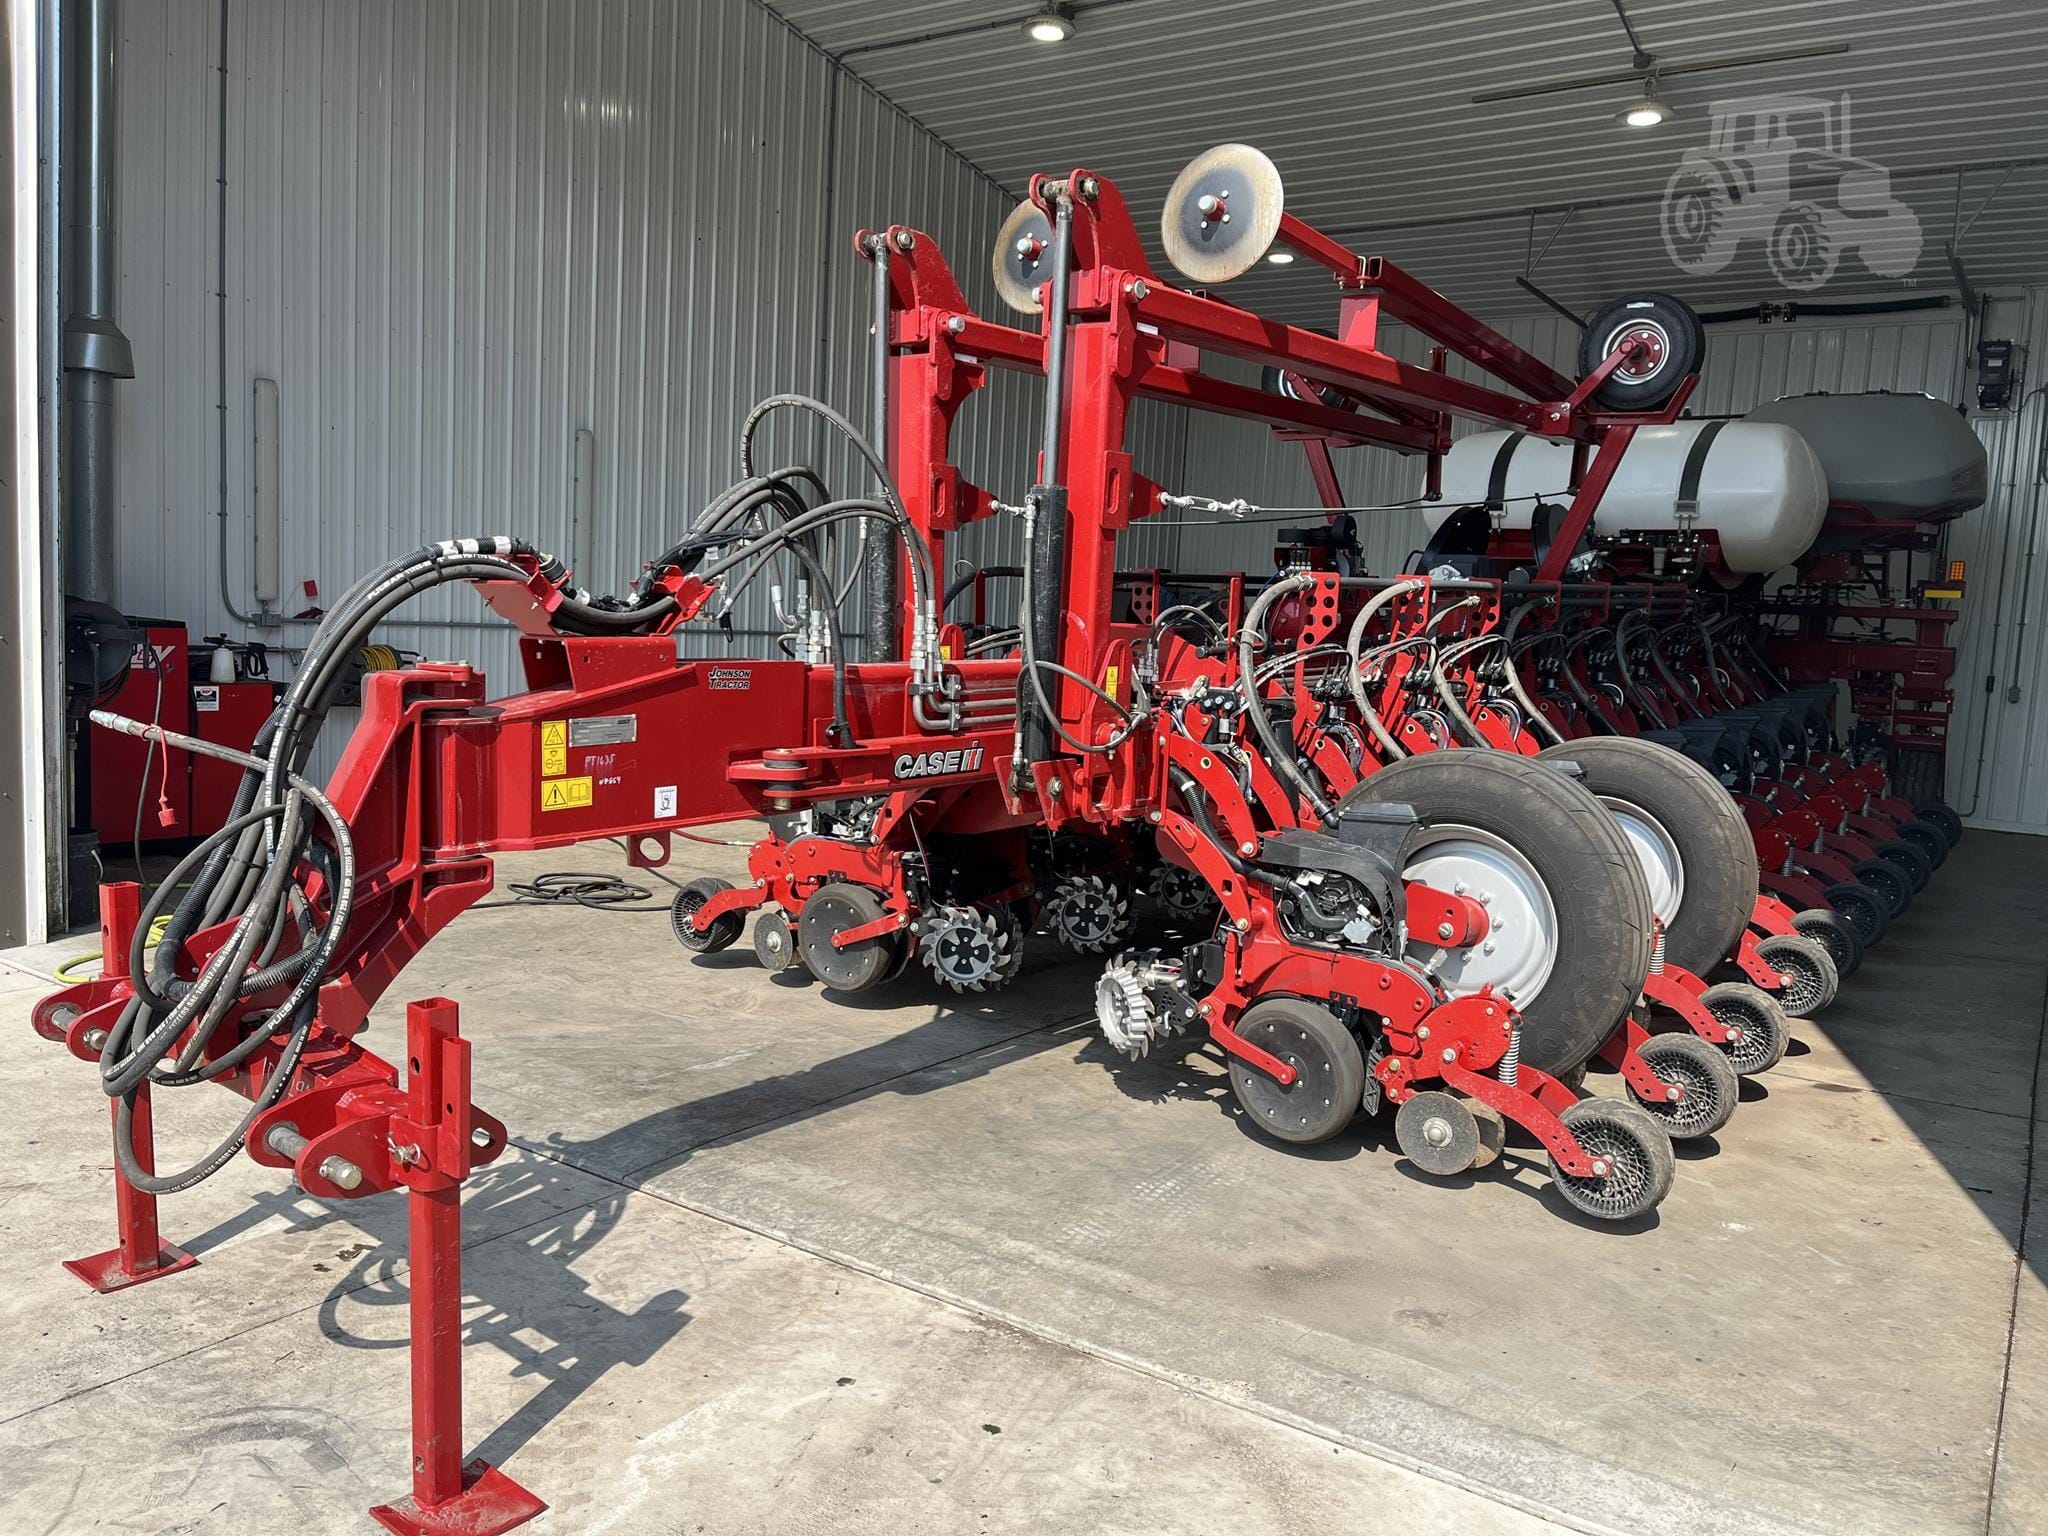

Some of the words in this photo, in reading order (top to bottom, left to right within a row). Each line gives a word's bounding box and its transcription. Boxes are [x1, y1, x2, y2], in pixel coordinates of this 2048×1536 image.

[709, 666, 751, 678] JOHNSON
[709, 678, 750, 689] TRACTOR
[894, 751, 961, 779] CASE
[268, 988, 305, 1030] PULSAR
